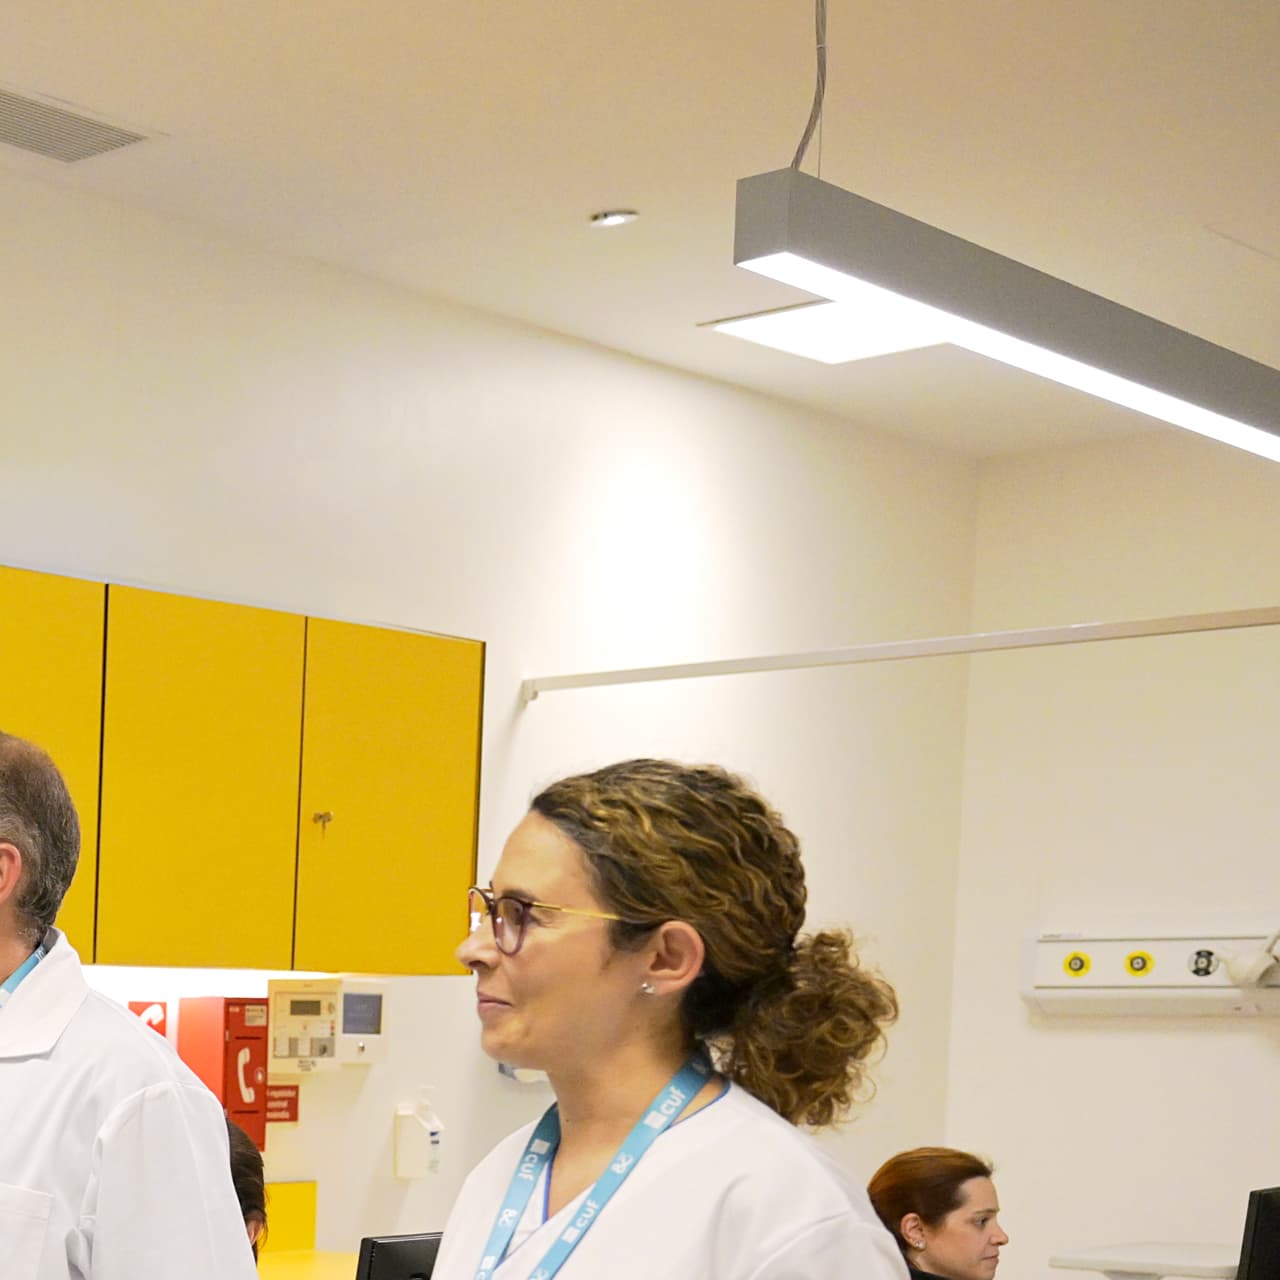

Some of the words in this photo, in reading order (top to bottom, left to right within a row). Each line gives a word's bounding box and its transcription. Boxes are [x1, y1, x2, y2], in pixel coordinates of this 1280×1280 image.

[659, 1085, 686, 1115] cuf
[518, 1154, 538, 1181] cuf
[575, 1199, 600, 1228] cuf
